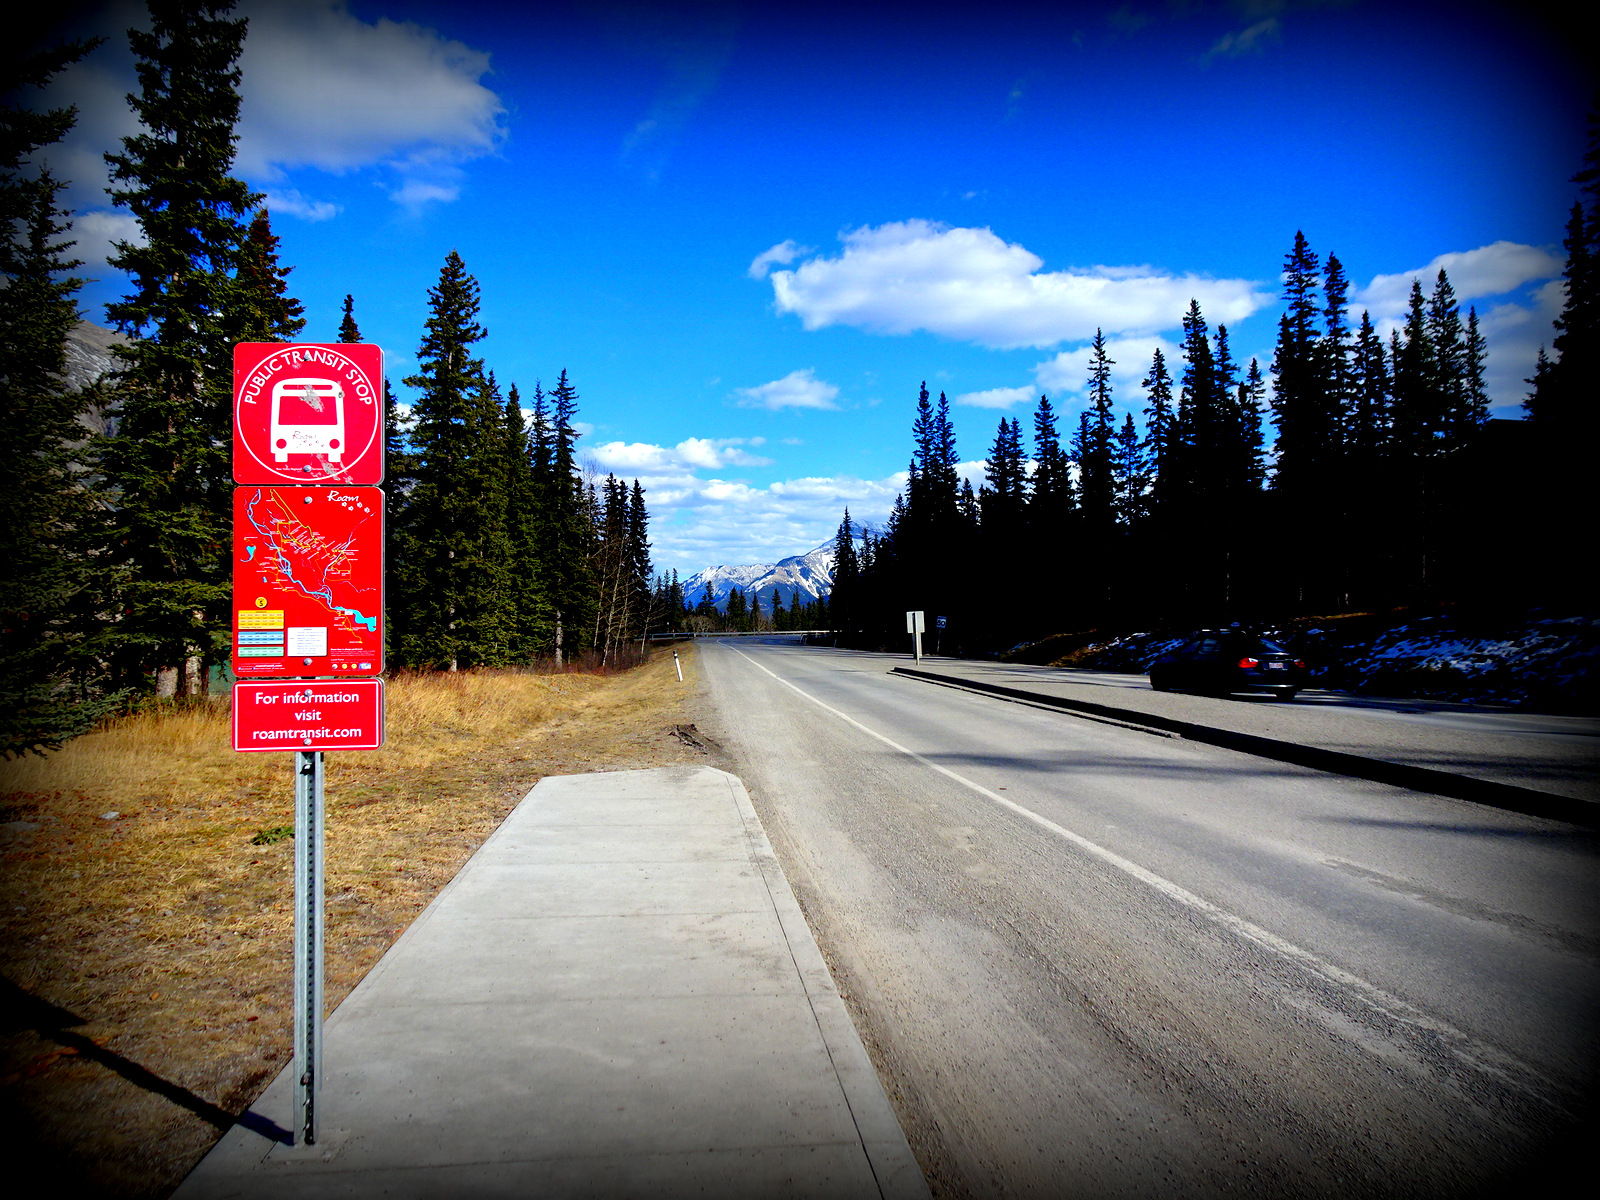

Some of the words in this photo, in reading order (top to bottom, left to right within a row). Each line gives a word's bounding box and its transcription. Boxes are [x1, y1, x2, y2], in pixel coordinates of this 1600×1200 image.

[244, 358, 283, 404] PUBLIC
[280, 350, 349, 371] TRANSIT
[345, 369, 372, 405] STOP
[327, 490, 359, 502] Roam
[255, 692, 279, 704] For
[283, 691, 360, 704] information
[294, 709, 322, 721] visit
[252, 727, 362, 740] roamtransit.com
